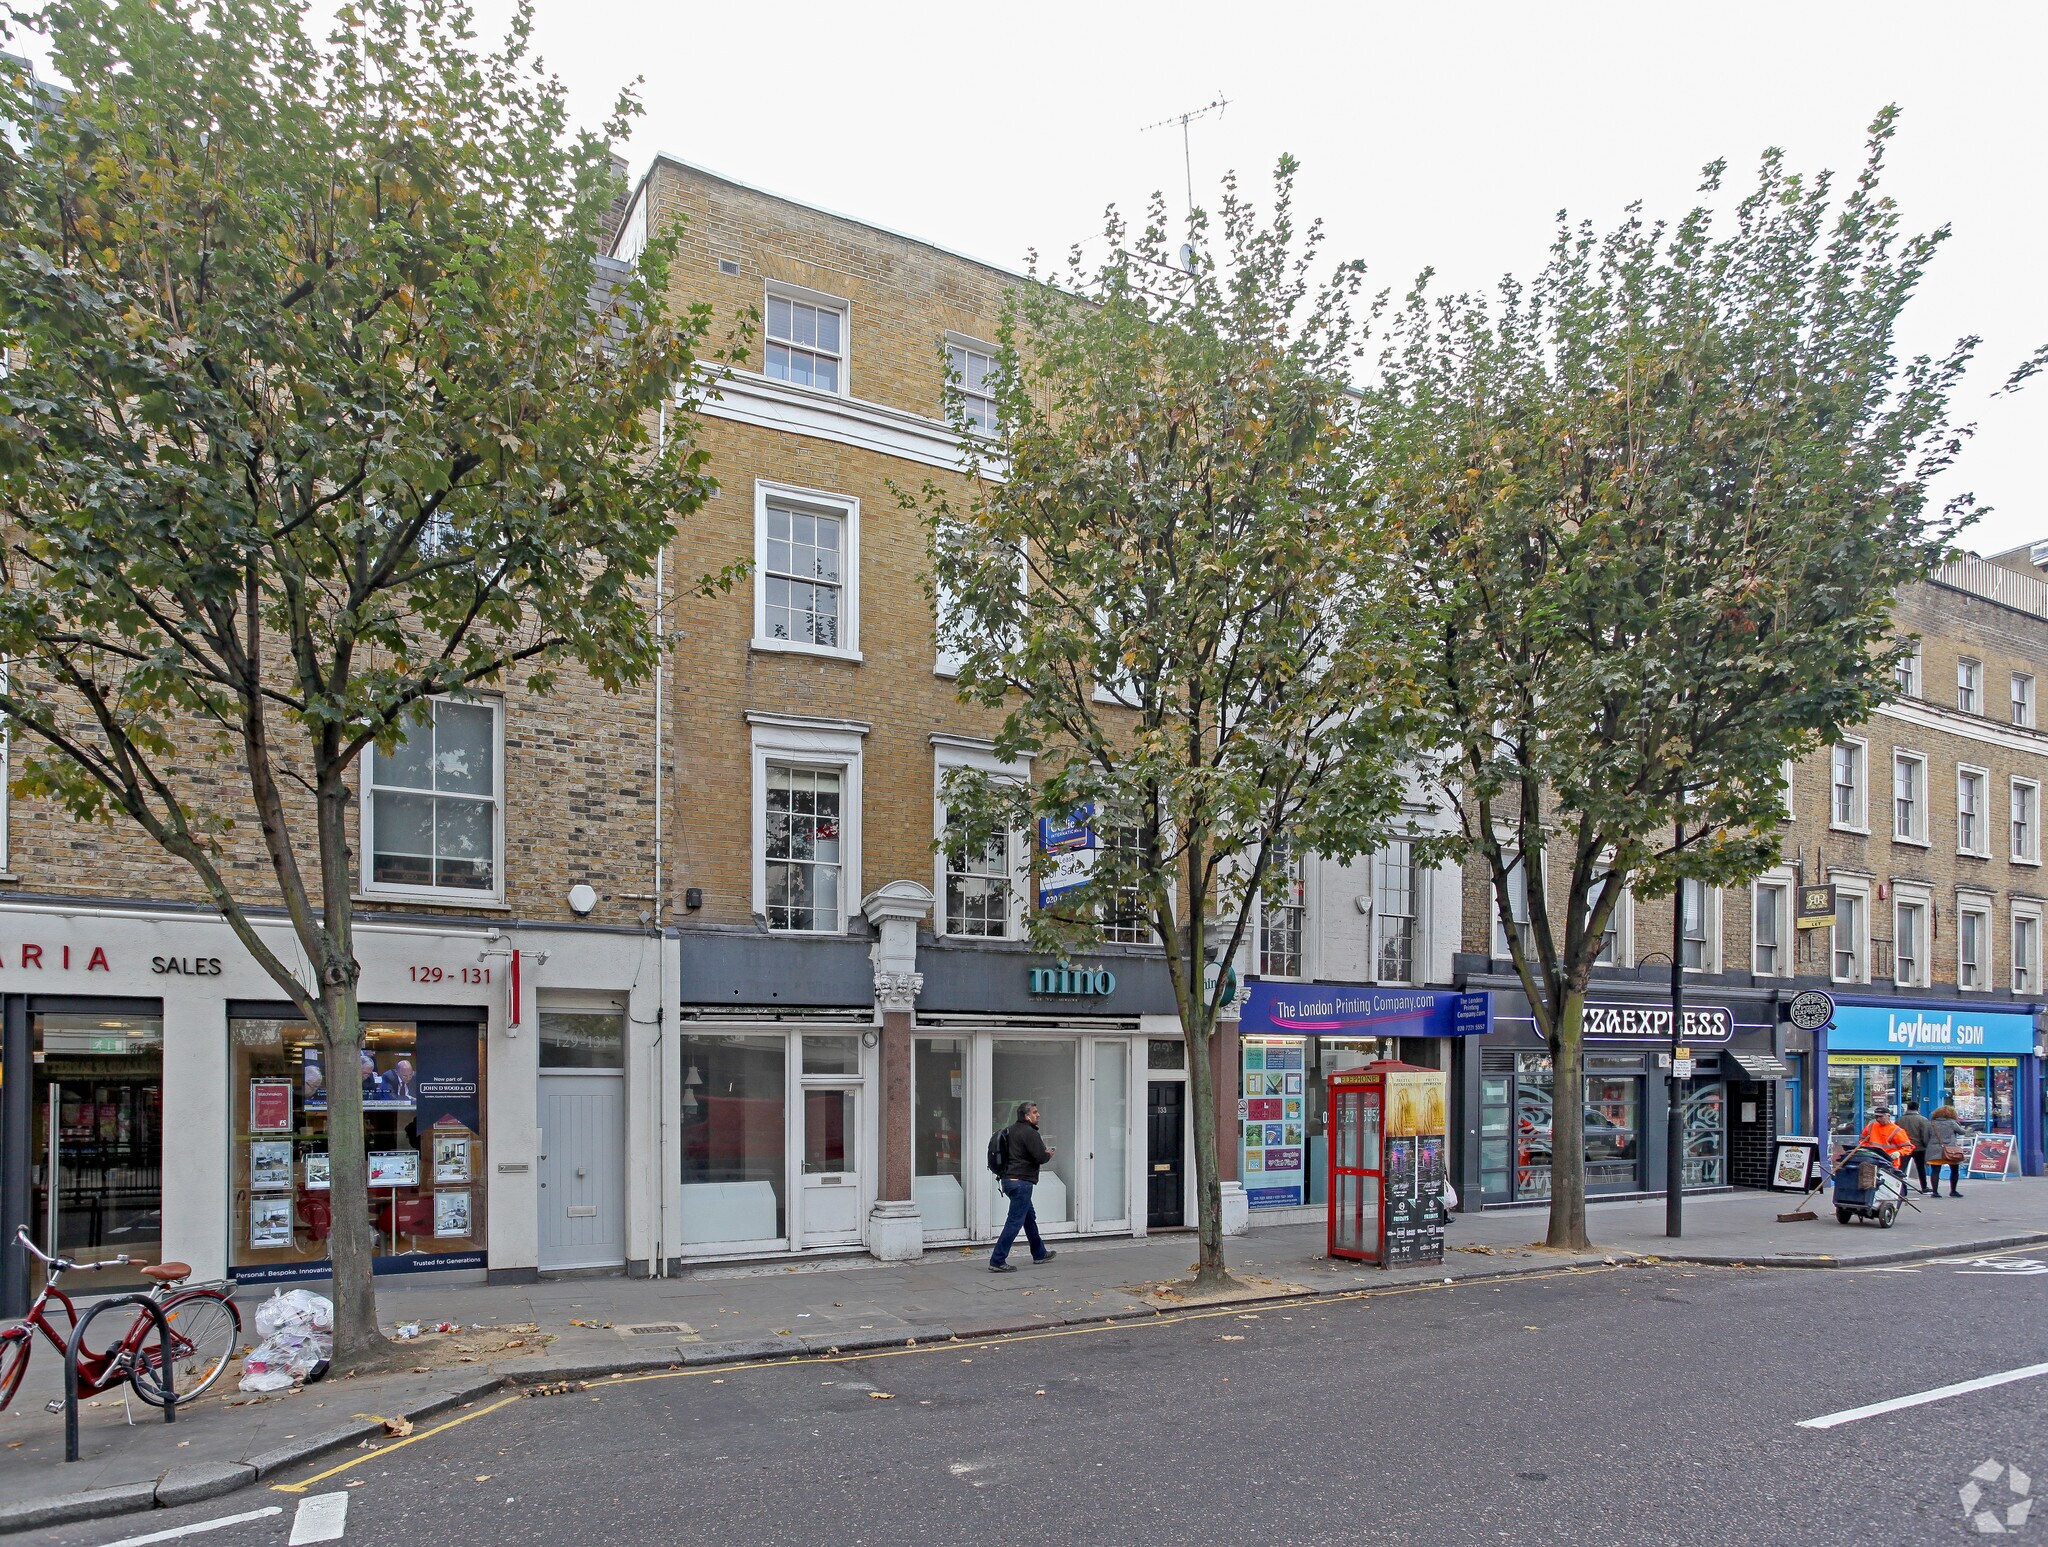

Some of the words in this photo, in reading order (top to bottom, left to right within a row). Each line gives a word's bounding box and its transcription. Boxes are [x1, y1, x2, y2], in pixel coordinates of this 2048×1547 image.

[152, 956, 222, 976] SALES
[409, 966, 443, 983] 129
[461, 968, 491, 984] 131
[1028, 960, 1117, 996] nino
[1277, 1001, 1296, 1019] The
[1299, 1000, 1333, 1017] London
[1336, 997, 1371, 1016] Printing
[1373, 994, 1435, 1012] Company.com
[1457, 1010, 1486, 1018] Company.com
[1888, 1013, 1952, 1047] Leyland
[1956, 1025, 1985, 1045] SDM
[1340, 1074, 1379, 1083] ELEPHONE
[1158, 1106, 1167, 1114] 133
[413, 1259, 435, 1267] Trusted
[446, 1257, 481, 1265] Generations
[236, 1270, 266, 1279] Personal.
[268, 1269, 298, 1278] Bespoke.
